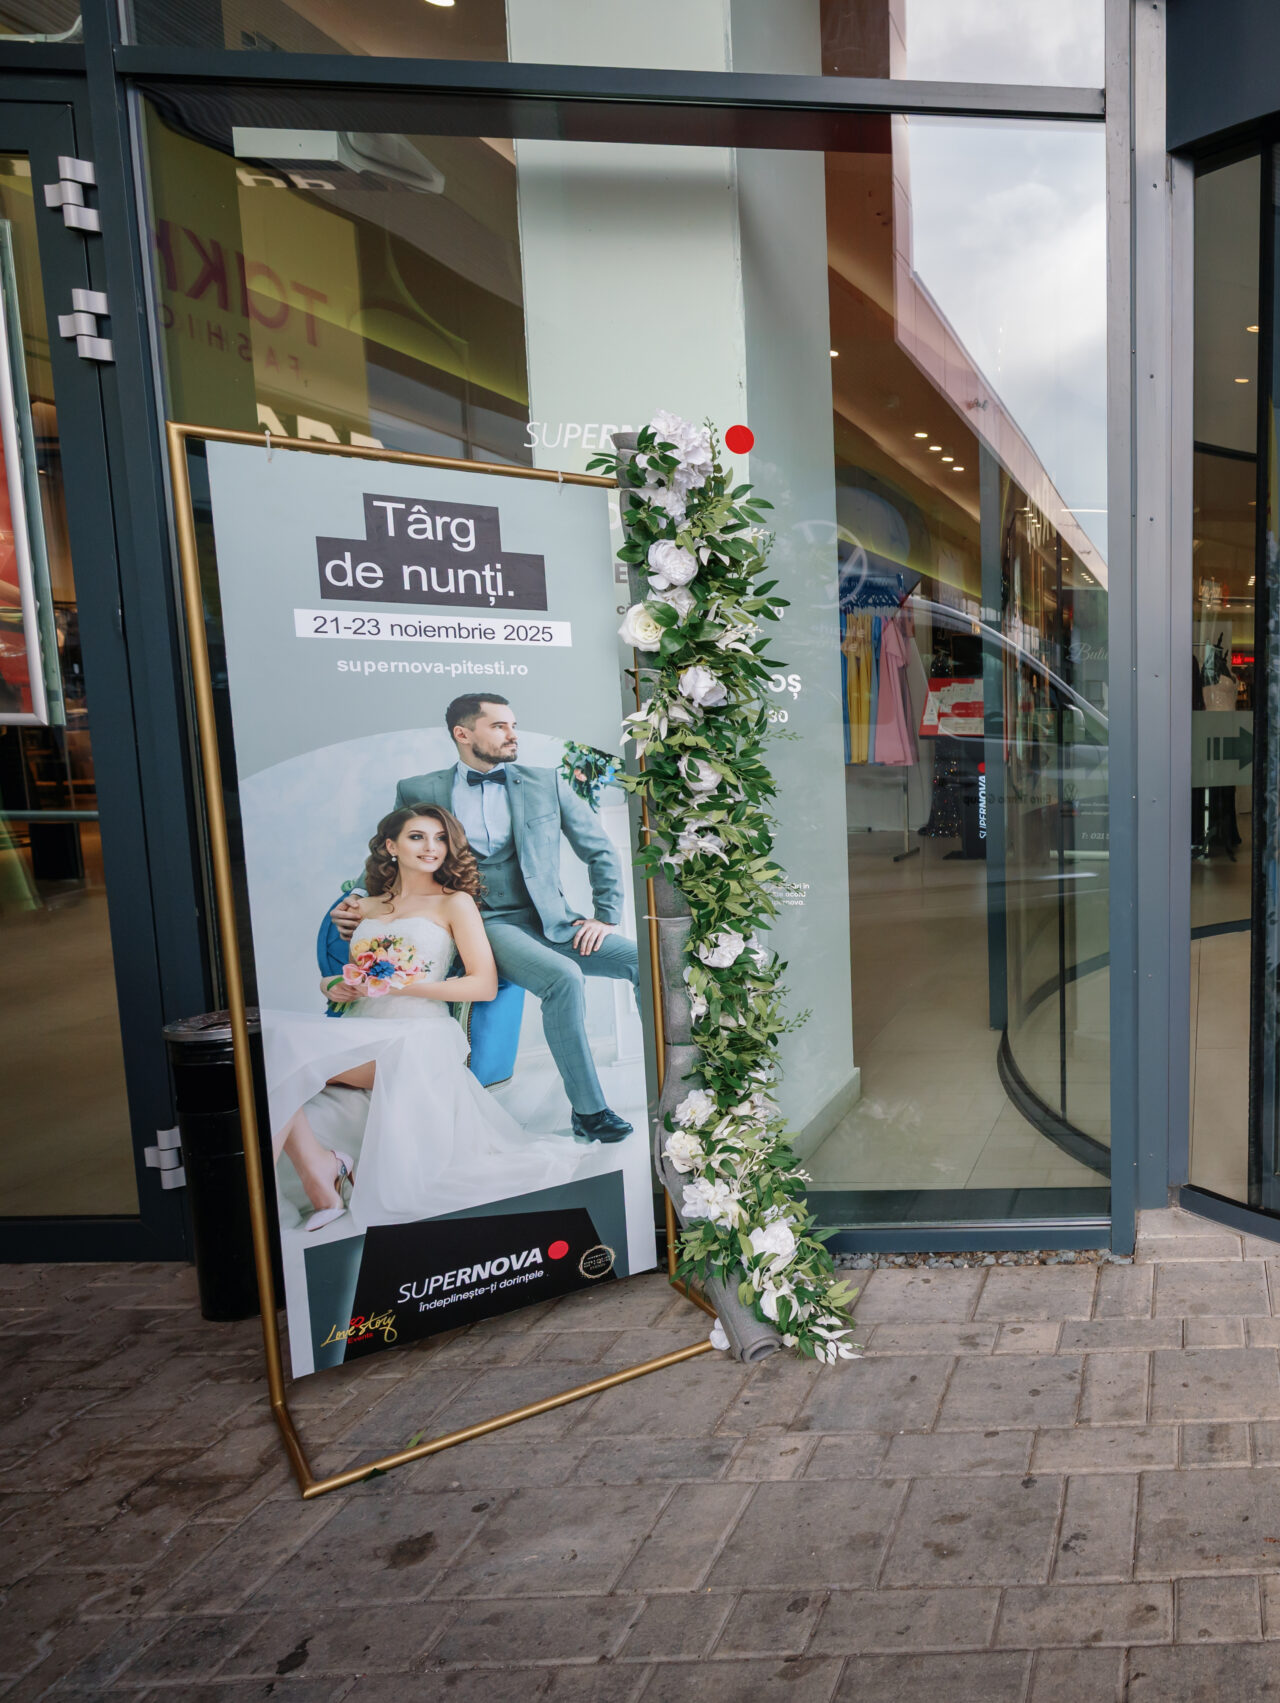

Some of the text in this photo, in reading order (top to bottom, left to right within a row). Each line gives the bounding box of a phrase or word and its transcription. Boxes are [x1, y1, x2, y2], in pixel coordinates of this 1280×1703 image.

[523, 421, 649, 449] SUPER
[372, 500, 476, 552] Târg
[325, 552, 515, 606] de nunți.
[313, 615, 553, 642] 21-23 noiembrie 2025
[337, 659, 529, 678] supernova-pitesti.ro
[397, 1247, 544, 1304] SUPERNOVA
